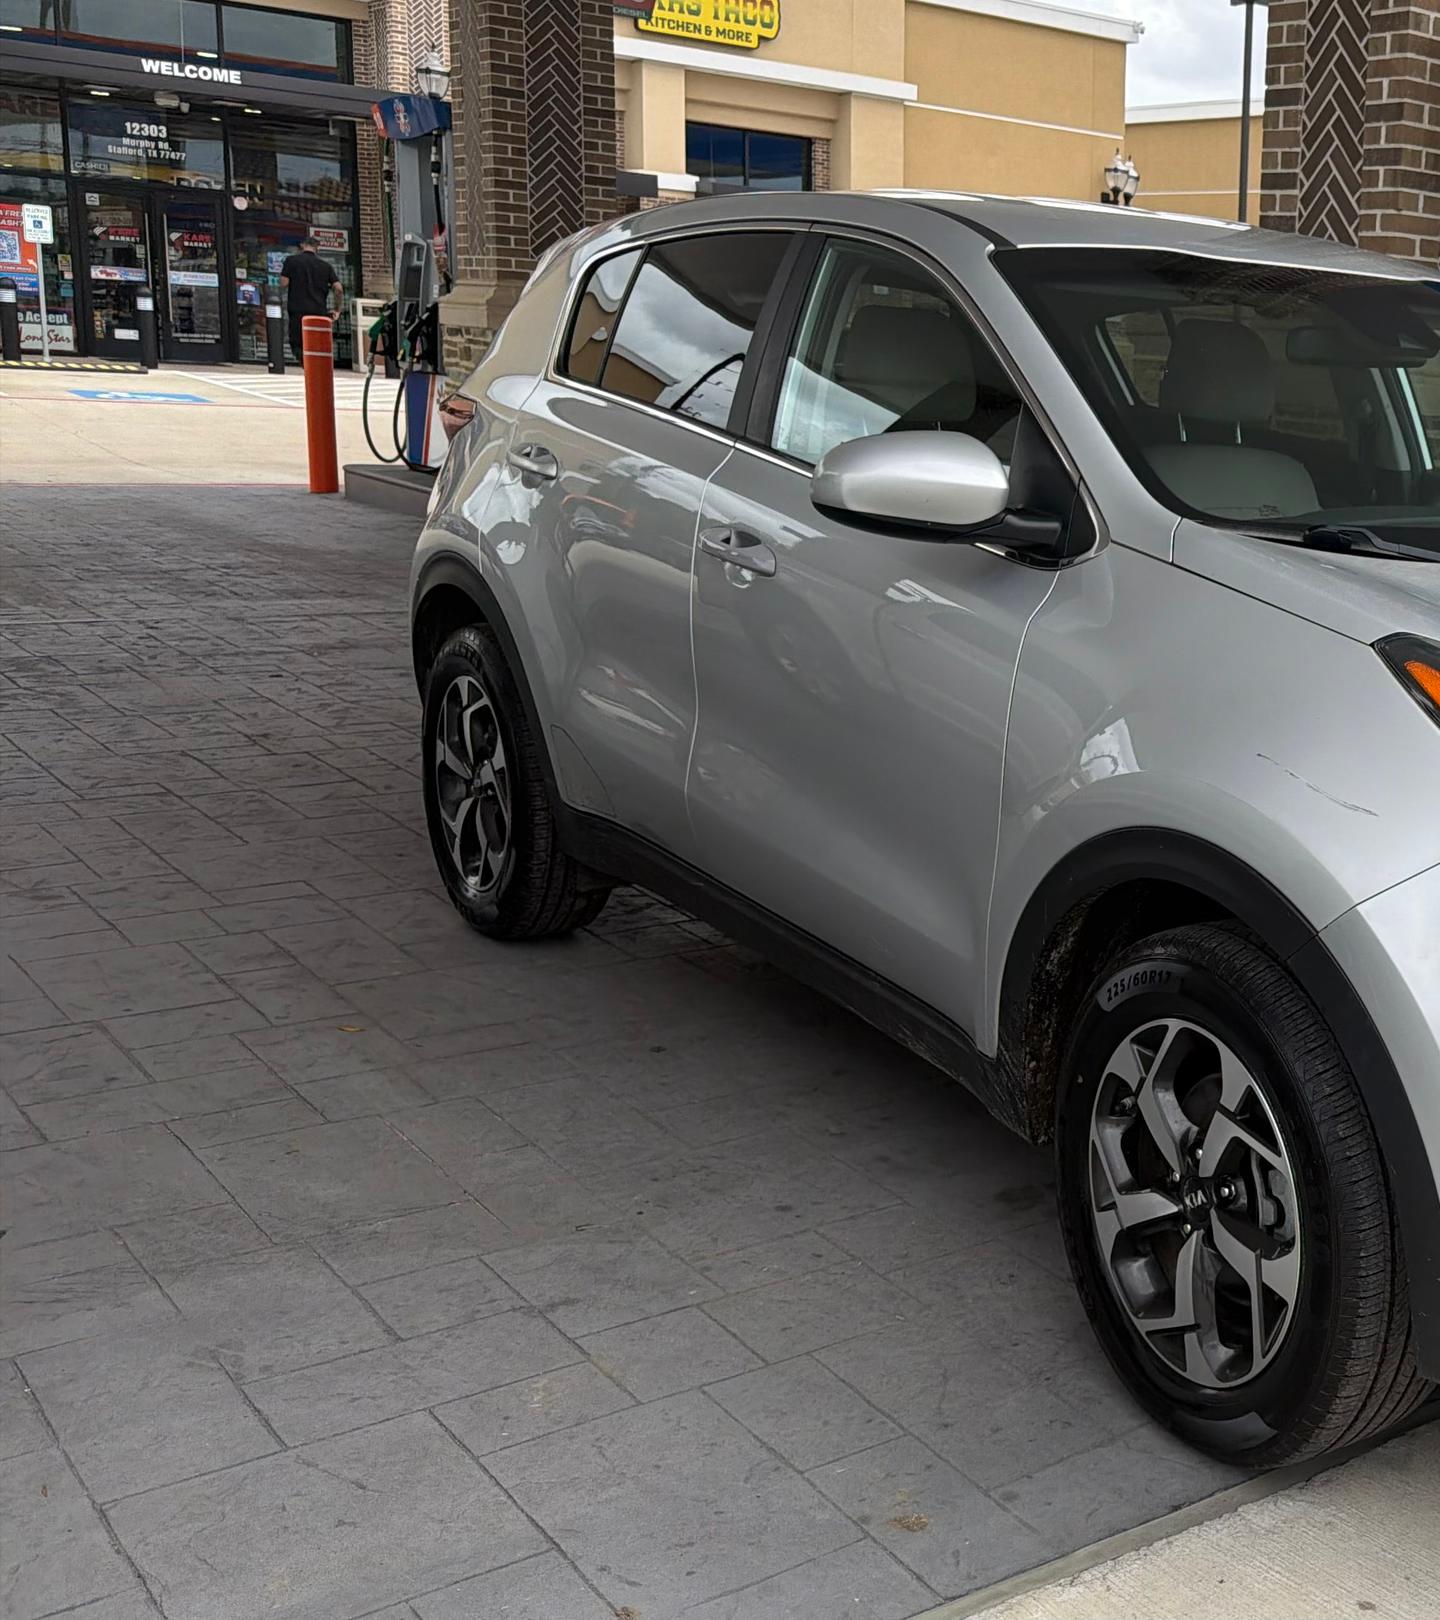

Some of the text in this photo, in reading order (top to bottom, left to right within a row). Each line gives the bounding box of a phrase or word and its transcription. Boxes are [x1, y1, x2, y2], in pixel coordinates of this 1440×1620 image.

[613, 7, 649, 18] DIESEL
[645, 16, 753, 43] KITCHEN & MORE
[141, 58, 242, 85] WELCOME
[124, 121, 168, 138] 12303
[122, 137, 156, 149] Murphy
[159, 150, 187, 161] 77477
[25, 311, 69, 324] Acept
[1107, 970, 1173, 1002] 225/60R17
[1184, 1190, 1208, 1211] KIA
